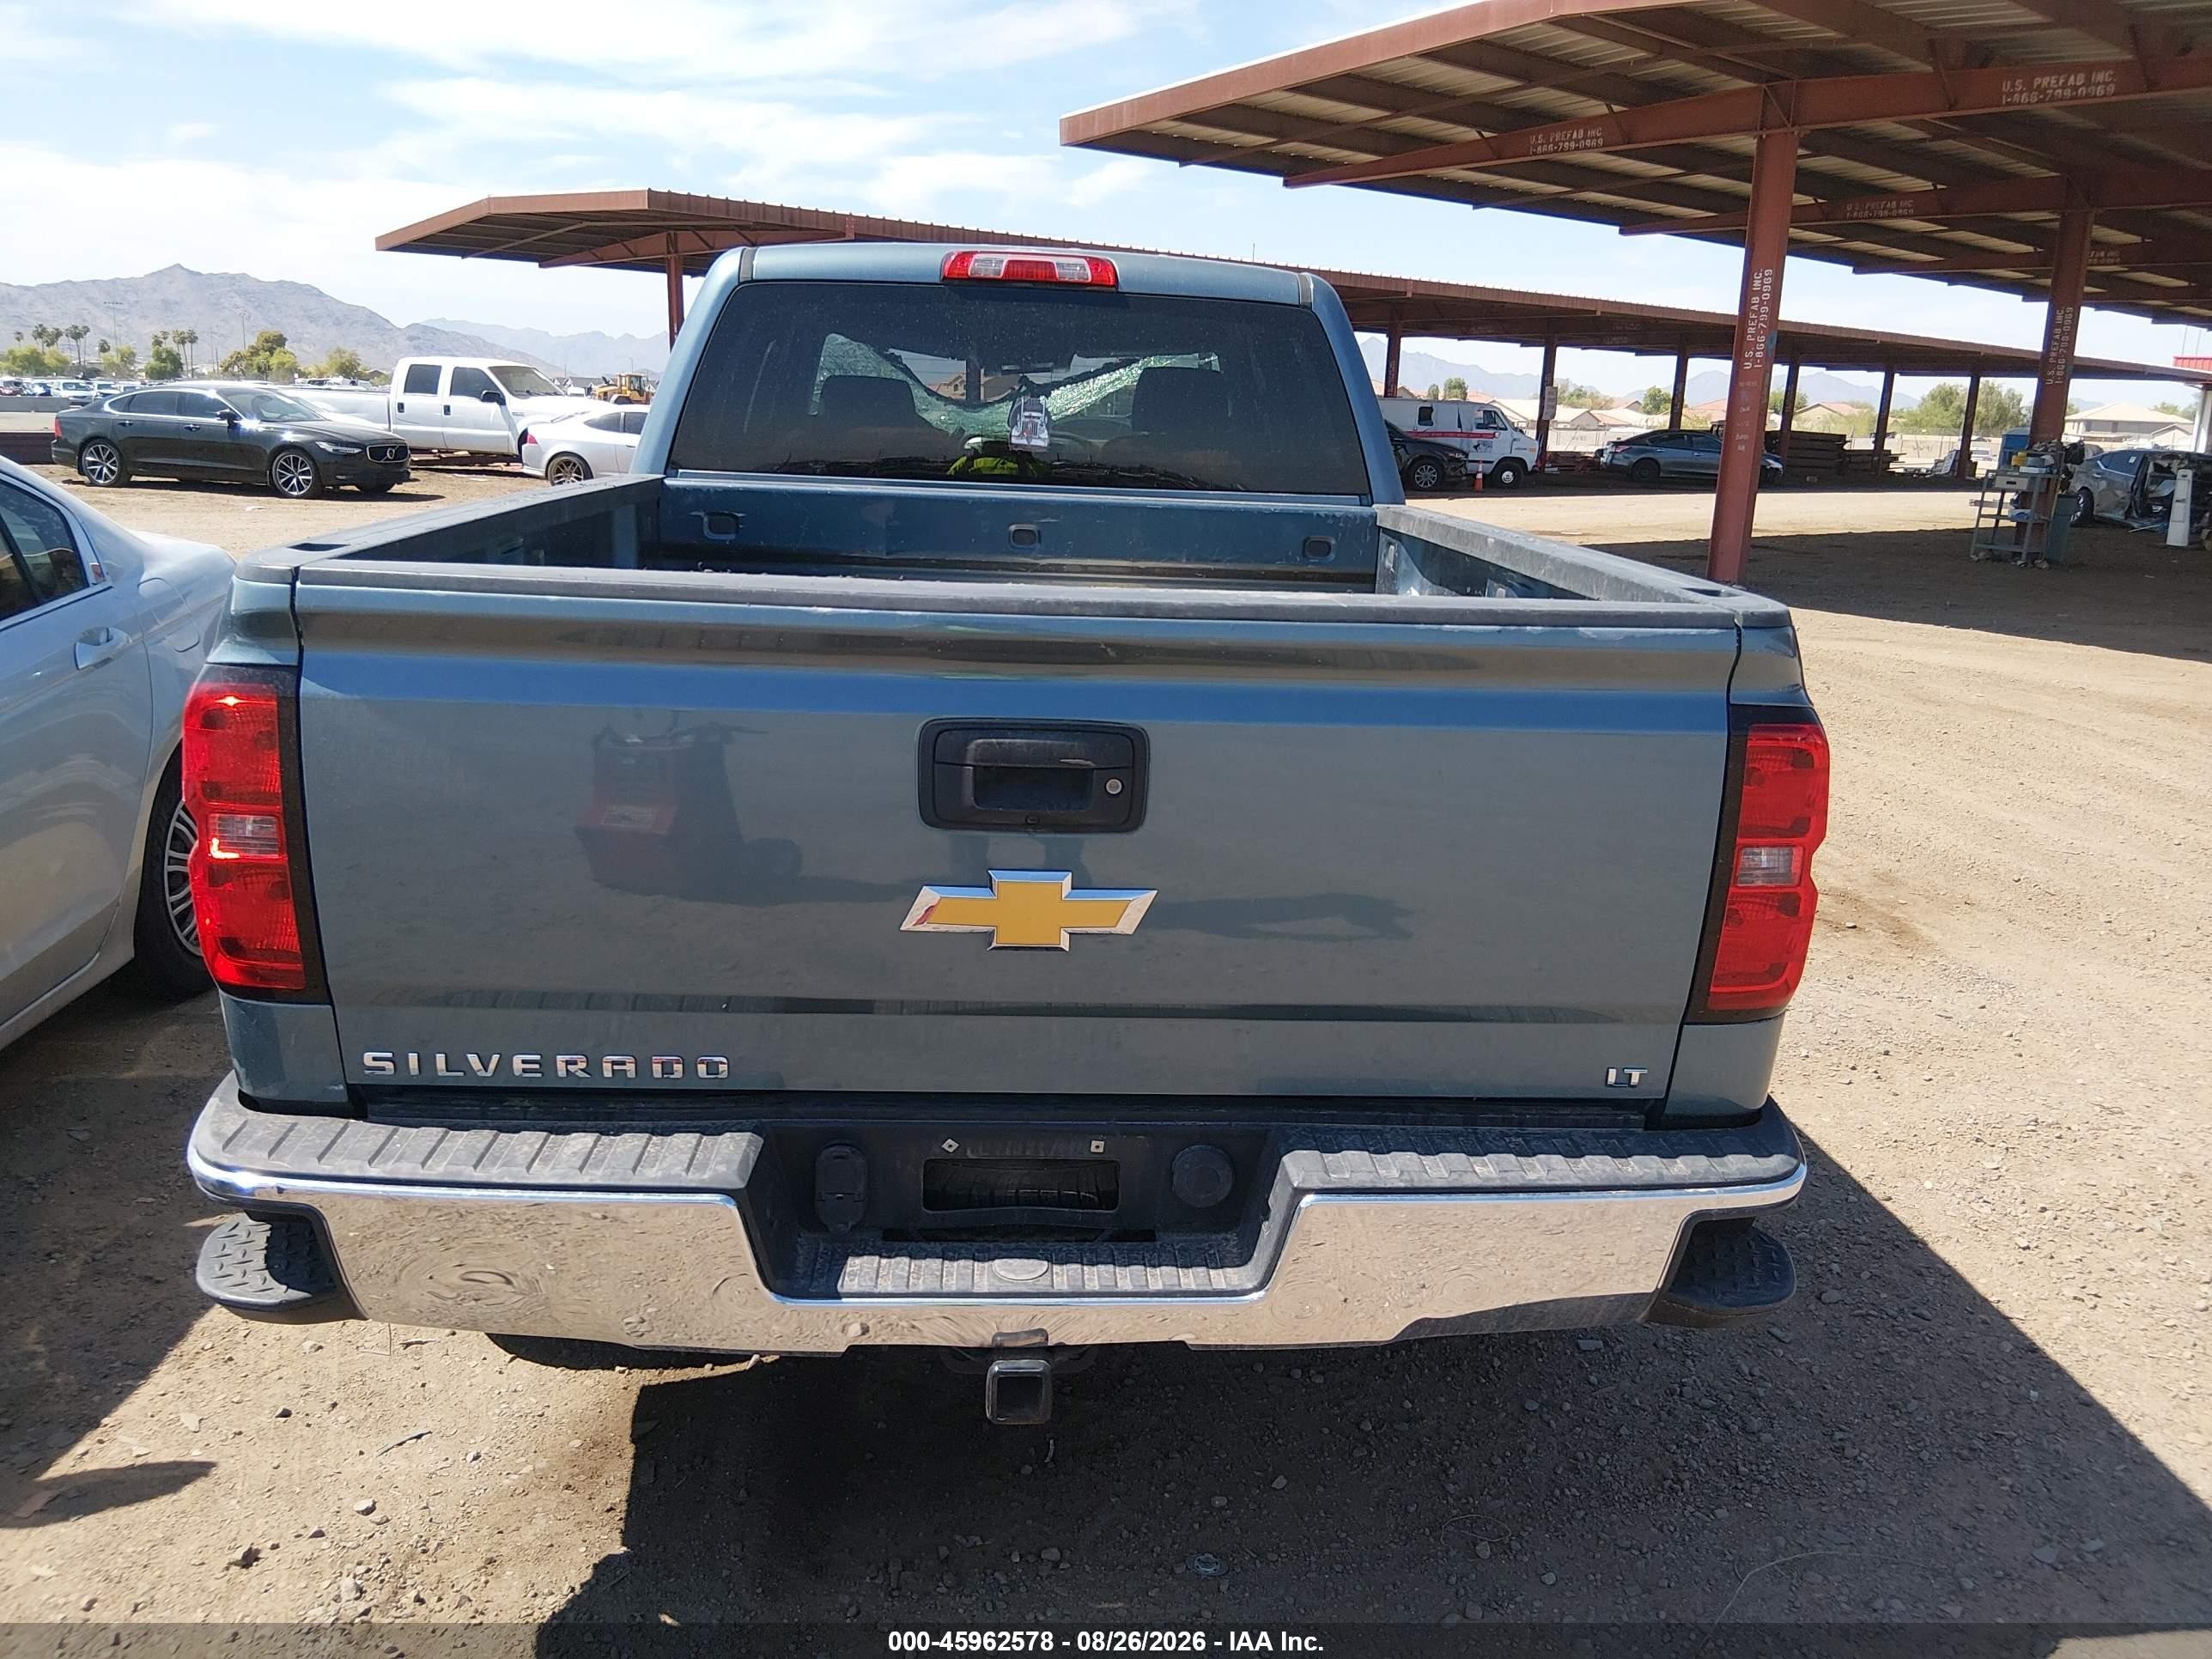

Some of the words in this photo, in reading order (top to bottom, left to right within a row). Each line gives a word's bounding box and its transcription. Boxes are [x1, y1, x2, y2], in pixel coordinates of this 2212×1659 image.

[2002, 79, 2027, 93] U.S.
[2033, 73, 2085, 89] PREFAB
[1529, 134, 1546, 145] U.S.
[1549, 129, 1584, 143] PREFAB
[1753, 269, 1763, 290] INC.
[1747, 295, 1759, 341] PREFAB
[1753, 269, 1773, 368] 1-866-799-0969
[2049, 328, 2062, 363] PREFAB
[1743, 348, 1754, 369] U.S.
[363, 1051, 730, 1079] SILVERADO
[1606, 1068, 1649, 1088] LT
